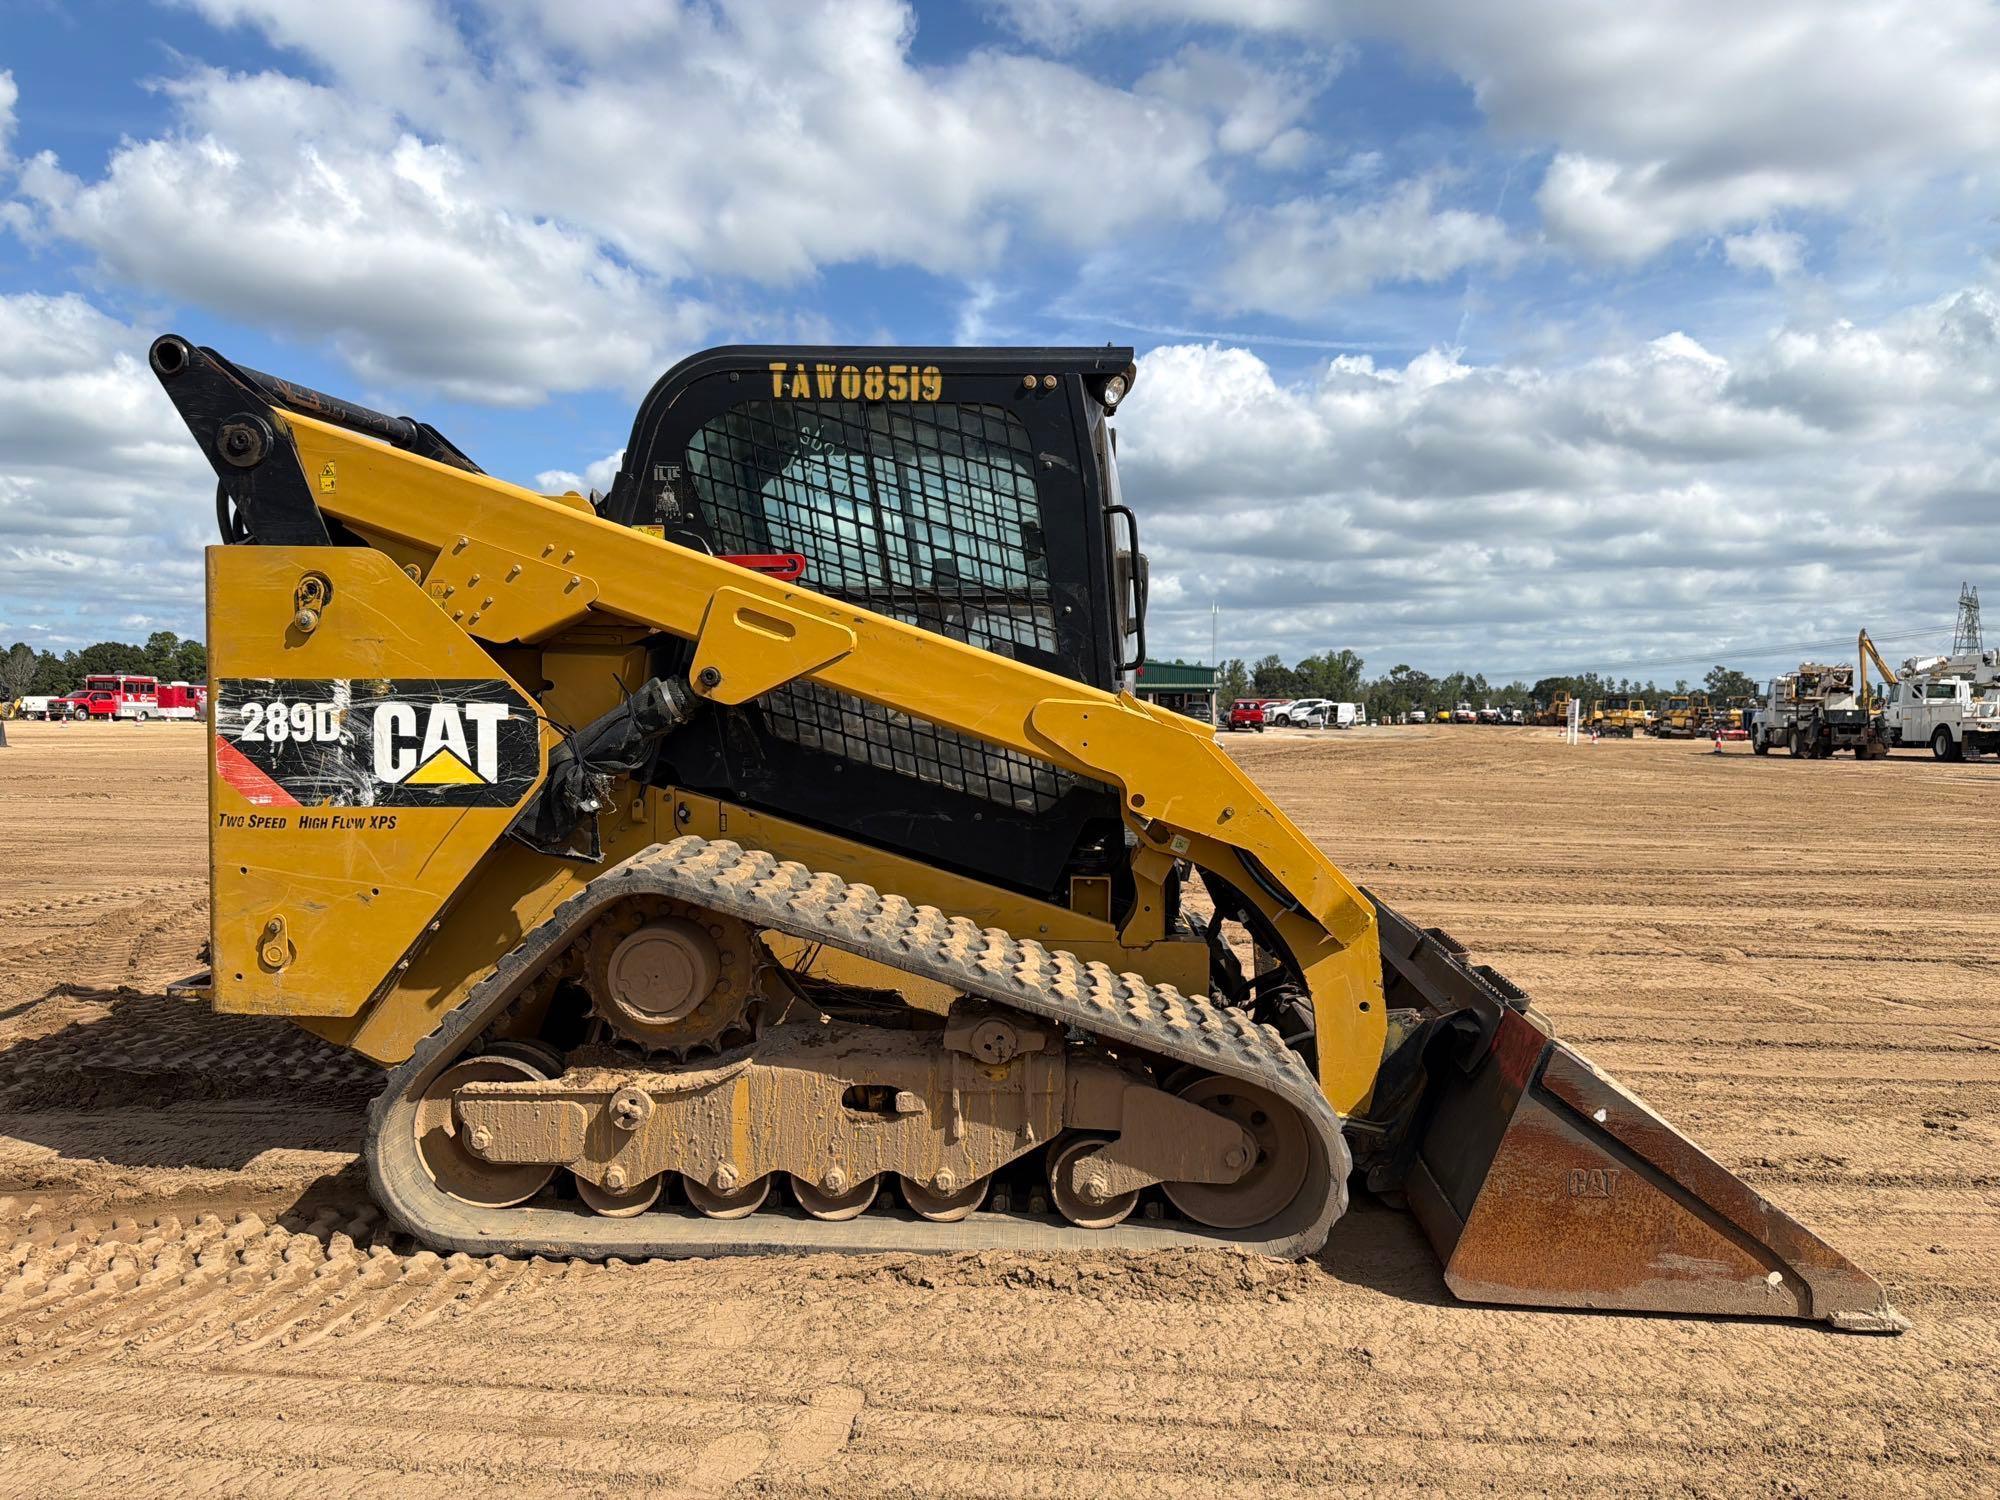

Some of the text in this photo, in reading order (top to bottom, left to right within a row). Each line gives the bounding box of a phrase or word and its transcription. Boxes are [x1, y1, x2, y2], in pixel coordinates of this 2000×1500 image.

[768, 362, 943, 402] TAW08519
[240, 702, 341, 742] 289D
[373, 701, 509, 785] CAT
[369, 815, 397, 829] XPS
[1567, 1167, 1620, 1200] CAT
